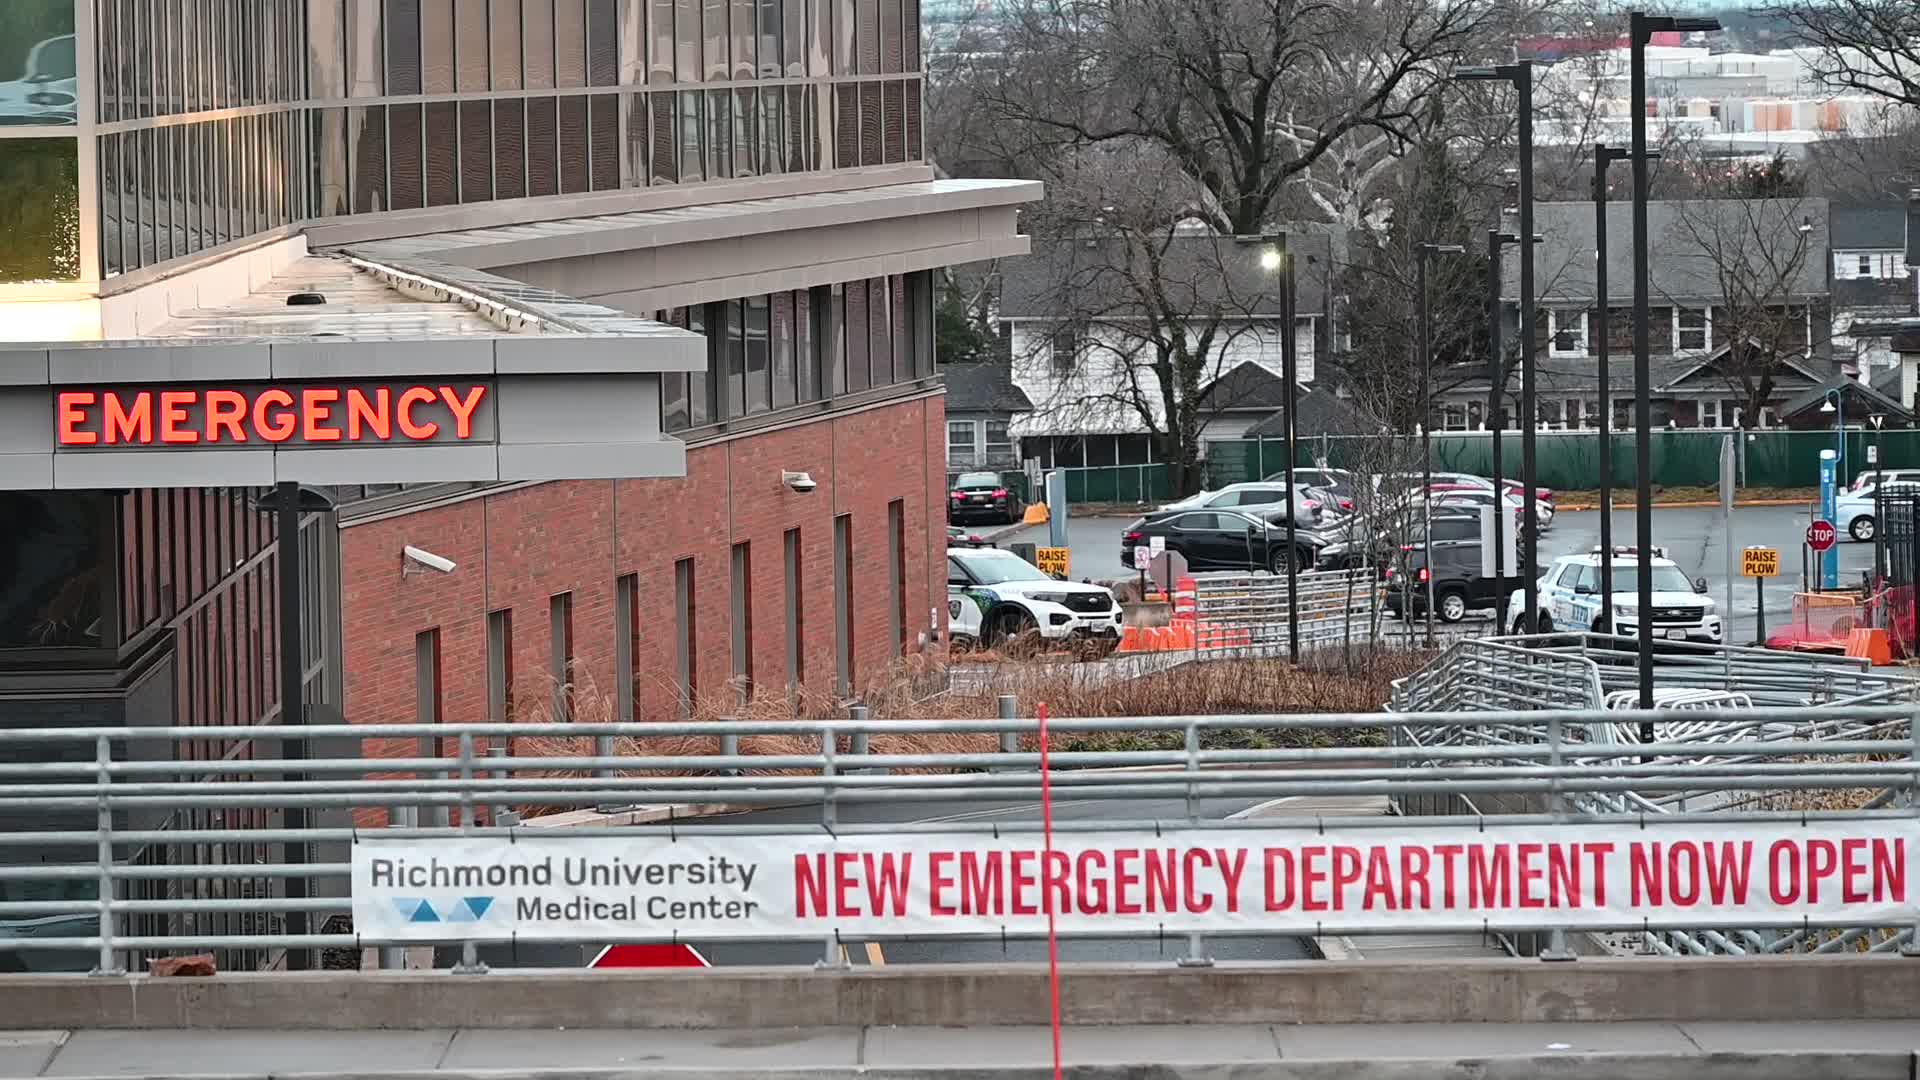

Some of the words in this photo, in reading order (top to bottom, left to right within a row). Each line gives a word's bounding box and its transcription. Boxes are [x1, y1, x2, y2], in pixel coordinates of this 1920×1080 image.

[57, 385, 487, 445] EMERGENCY
[1808, 529, 1834, 542] STOP
[1038, 550, 1067, 562] RAISE
[1745, 551, 1776, 562] RAISE
[1039, 562, 1066, 574] PLOW
[1745, 563, 1775, 574] PLOW
[372, 857, 552, 888] Richmond
[564, 855, 758, 891] University
[795, 852, 912, 918] NEW
[929, 847, 1248, 915] EMERGENCY
[1264, 842, 1615, 912] DEPARTMENT
[1630, 840, 1753, 908] NOW
[1769, 838, 1905, 906] OPEN
[517, 896, 637, 921] Medical
[646, 896, 759, 920] Center
